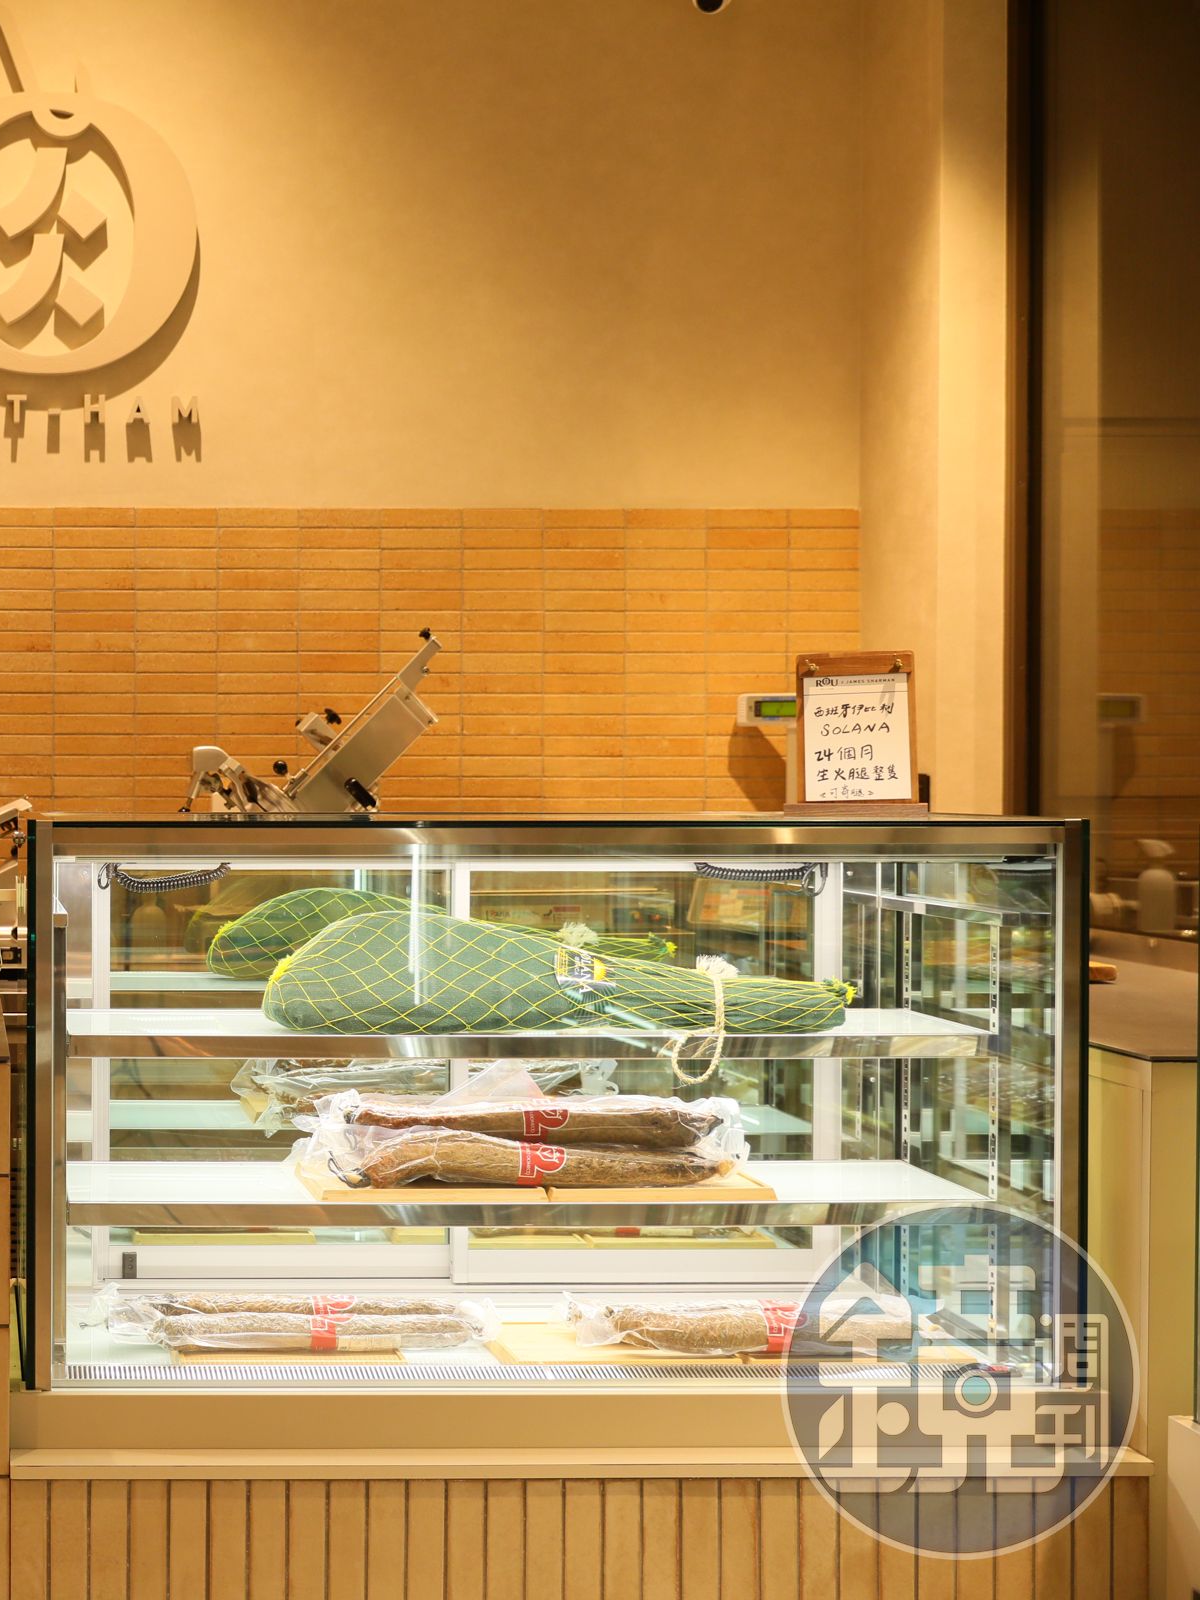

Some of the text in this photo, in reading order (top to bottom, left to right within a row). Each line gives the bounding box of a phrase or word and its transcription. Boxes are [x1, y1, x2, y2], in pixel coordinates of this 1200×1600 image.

[816, 677, 839, 687] ROU
[820, 722, 890, 737] SOLANA
[579, 951, 593, 993] OLANA
